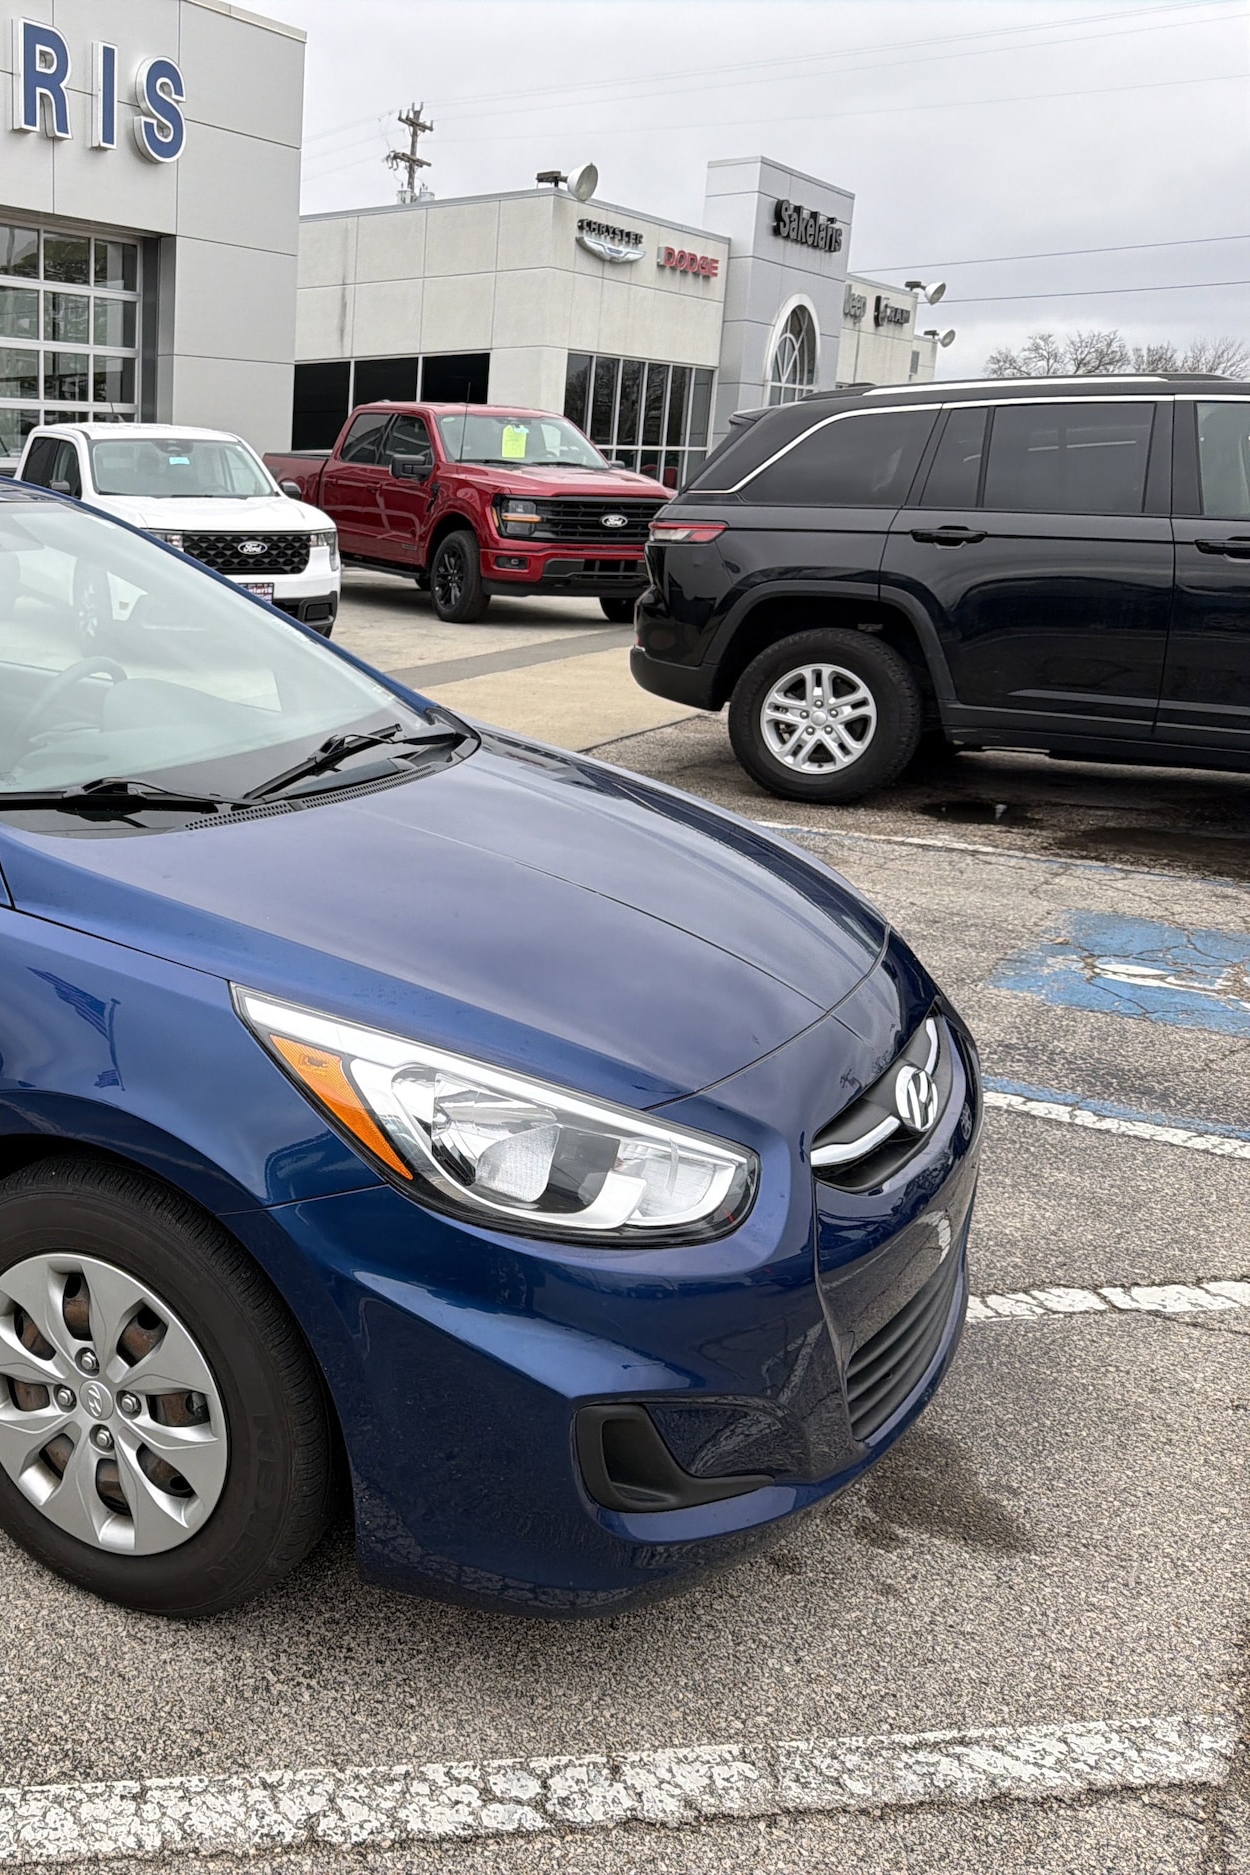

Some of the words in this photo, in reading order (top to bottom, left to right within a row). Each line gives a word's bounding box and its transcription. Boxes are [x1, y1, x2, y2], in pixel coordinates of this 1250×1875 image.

[577, 219, 643, 245] CHRYSLER
[774, 199, 843, 252] Sakelaris
[658, 246, 719, 277] DODGE
[887, 306, 910, 324] RAM
